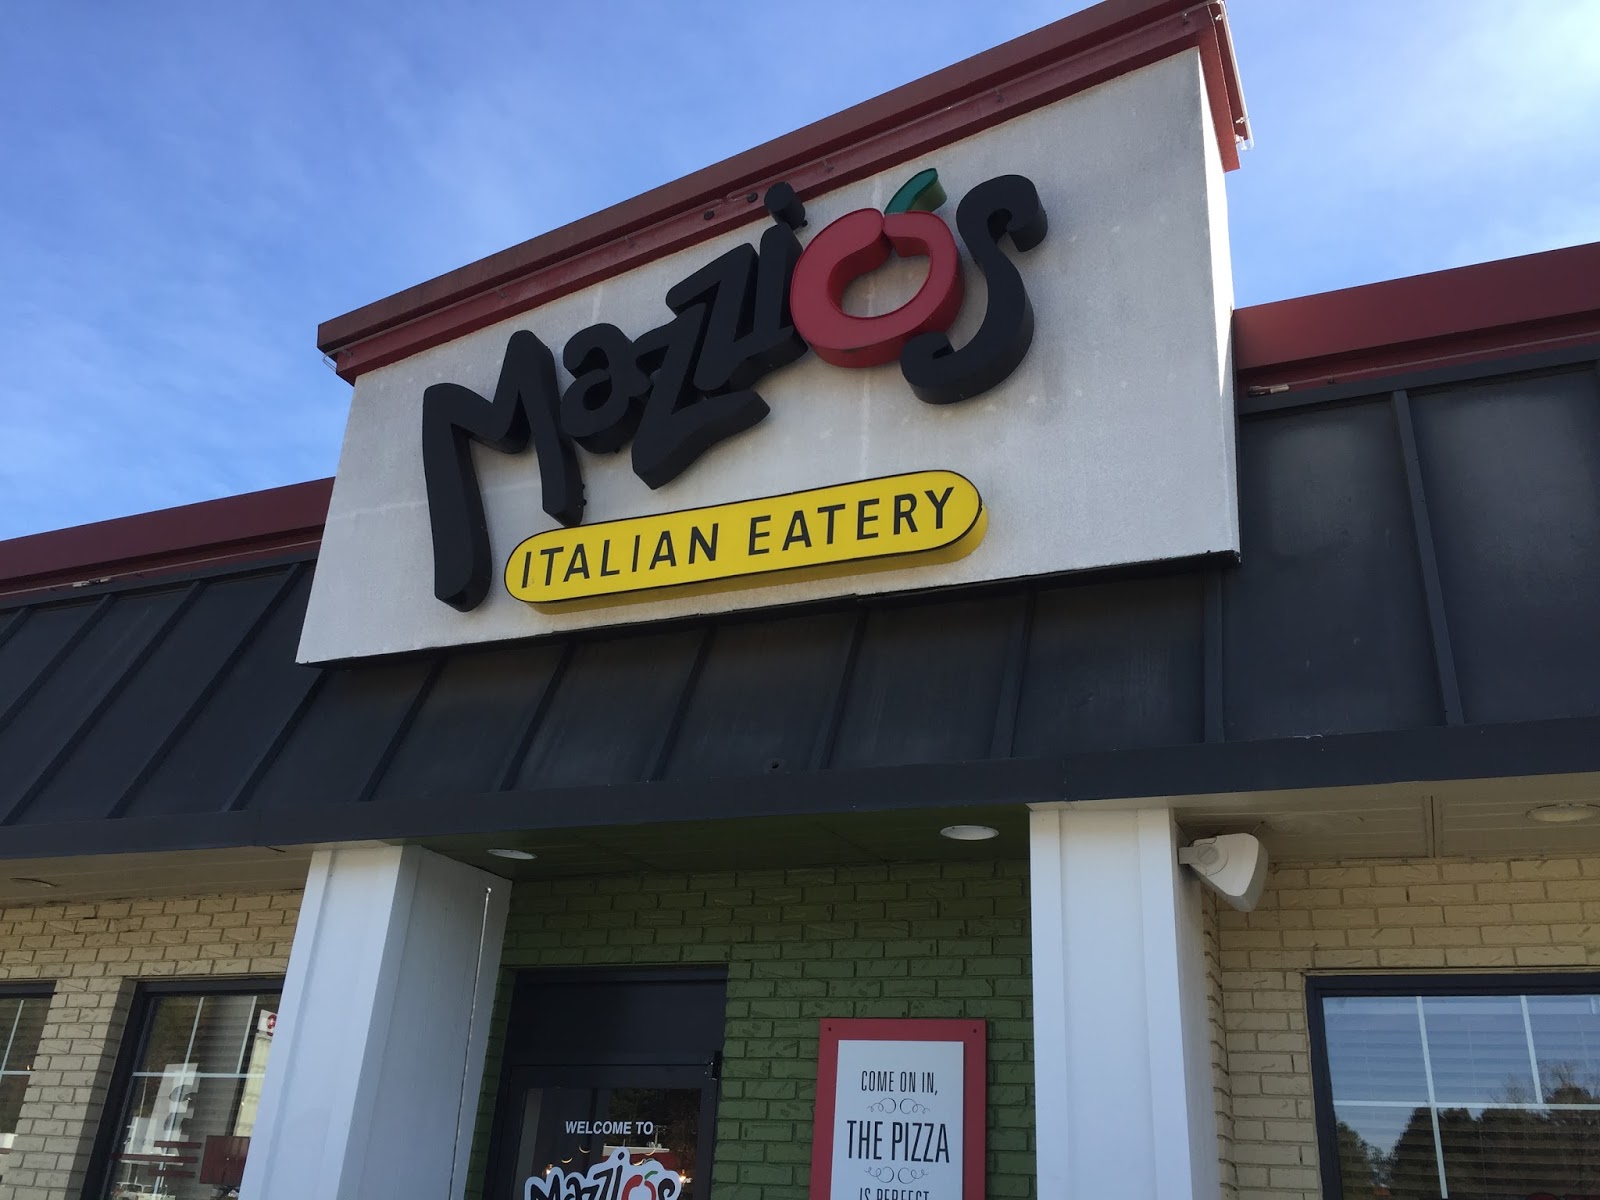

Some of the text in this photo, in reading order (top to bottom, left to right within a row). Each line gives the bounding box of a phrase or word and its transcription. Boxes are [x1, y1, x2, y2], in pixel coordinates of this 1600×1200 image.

[521, 486, 955, 589] ITALIAN EATERY
[861, 1070, 938, 1096] COME ON IN,
[565, 1121, 654, 1135] WELCOME TO
[847, 1120, 950, 1163] THE PIZZA
